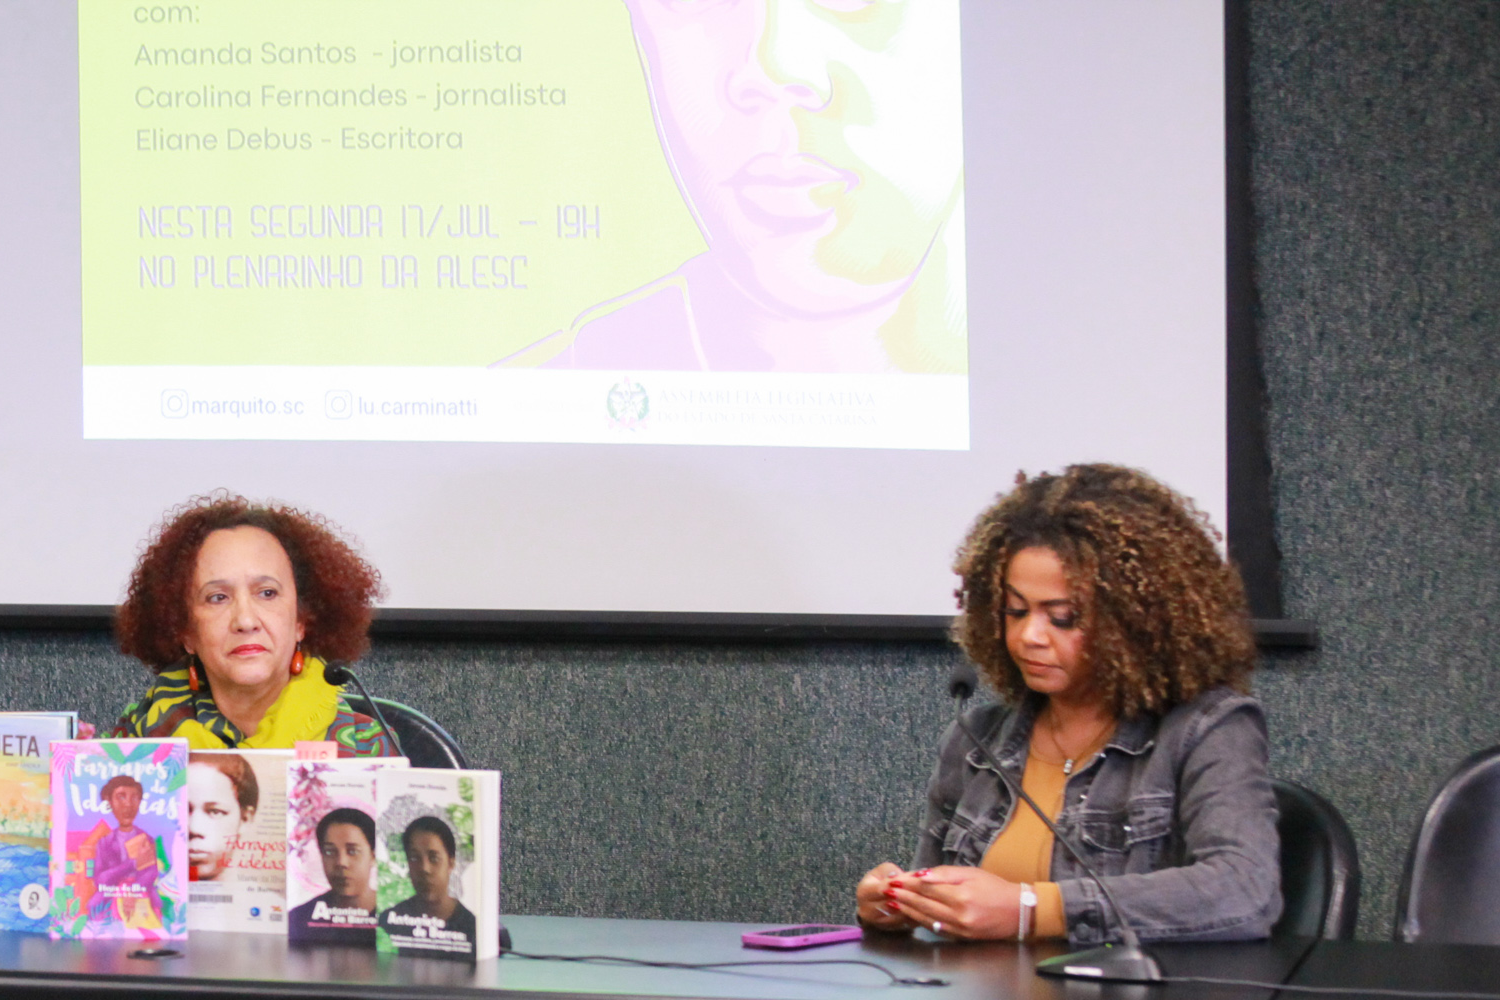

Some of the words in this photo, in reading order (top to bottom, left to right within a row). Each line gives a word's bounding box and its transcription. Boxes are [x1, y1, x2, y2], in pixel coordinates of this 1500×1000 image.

[133, 3, 200, 24] com:
[134, 42, 252, 66] Amanda
[260, 42, 357, 65] Santos
[390, 39, 523, 68] jornalista
[135, 85, 252, 109] Carolina
[262, 83, 408, 108] Fernandes
[433, 82, 567, 111] jornalista
[136, 128, 218, 151] Eliane
[227, 127, 313, 151] Debus
[341, 127, 463, 150] Escritora
[138, 205, 233, 238] NESTA
[250, 205, 384, 238] SEGUNDA
[401, 204, 500, 238] 17/JUL
[556, 205, 601, 238] 19H
[138, 255, 176, 289] NO
[194, 255, 363, 289] PLENARINHO
[382, 255, 418, 289] DA
[437, 255, 529, 290] ALESC
[191, 396, 306, 419] marquito.sc
[358, 396, 479, 418] lu.carminatti
[73, 752, 169, 783] Farrapos
[150, 779, 168, 795] de
[224, 834, 286, 858] Farrapos
